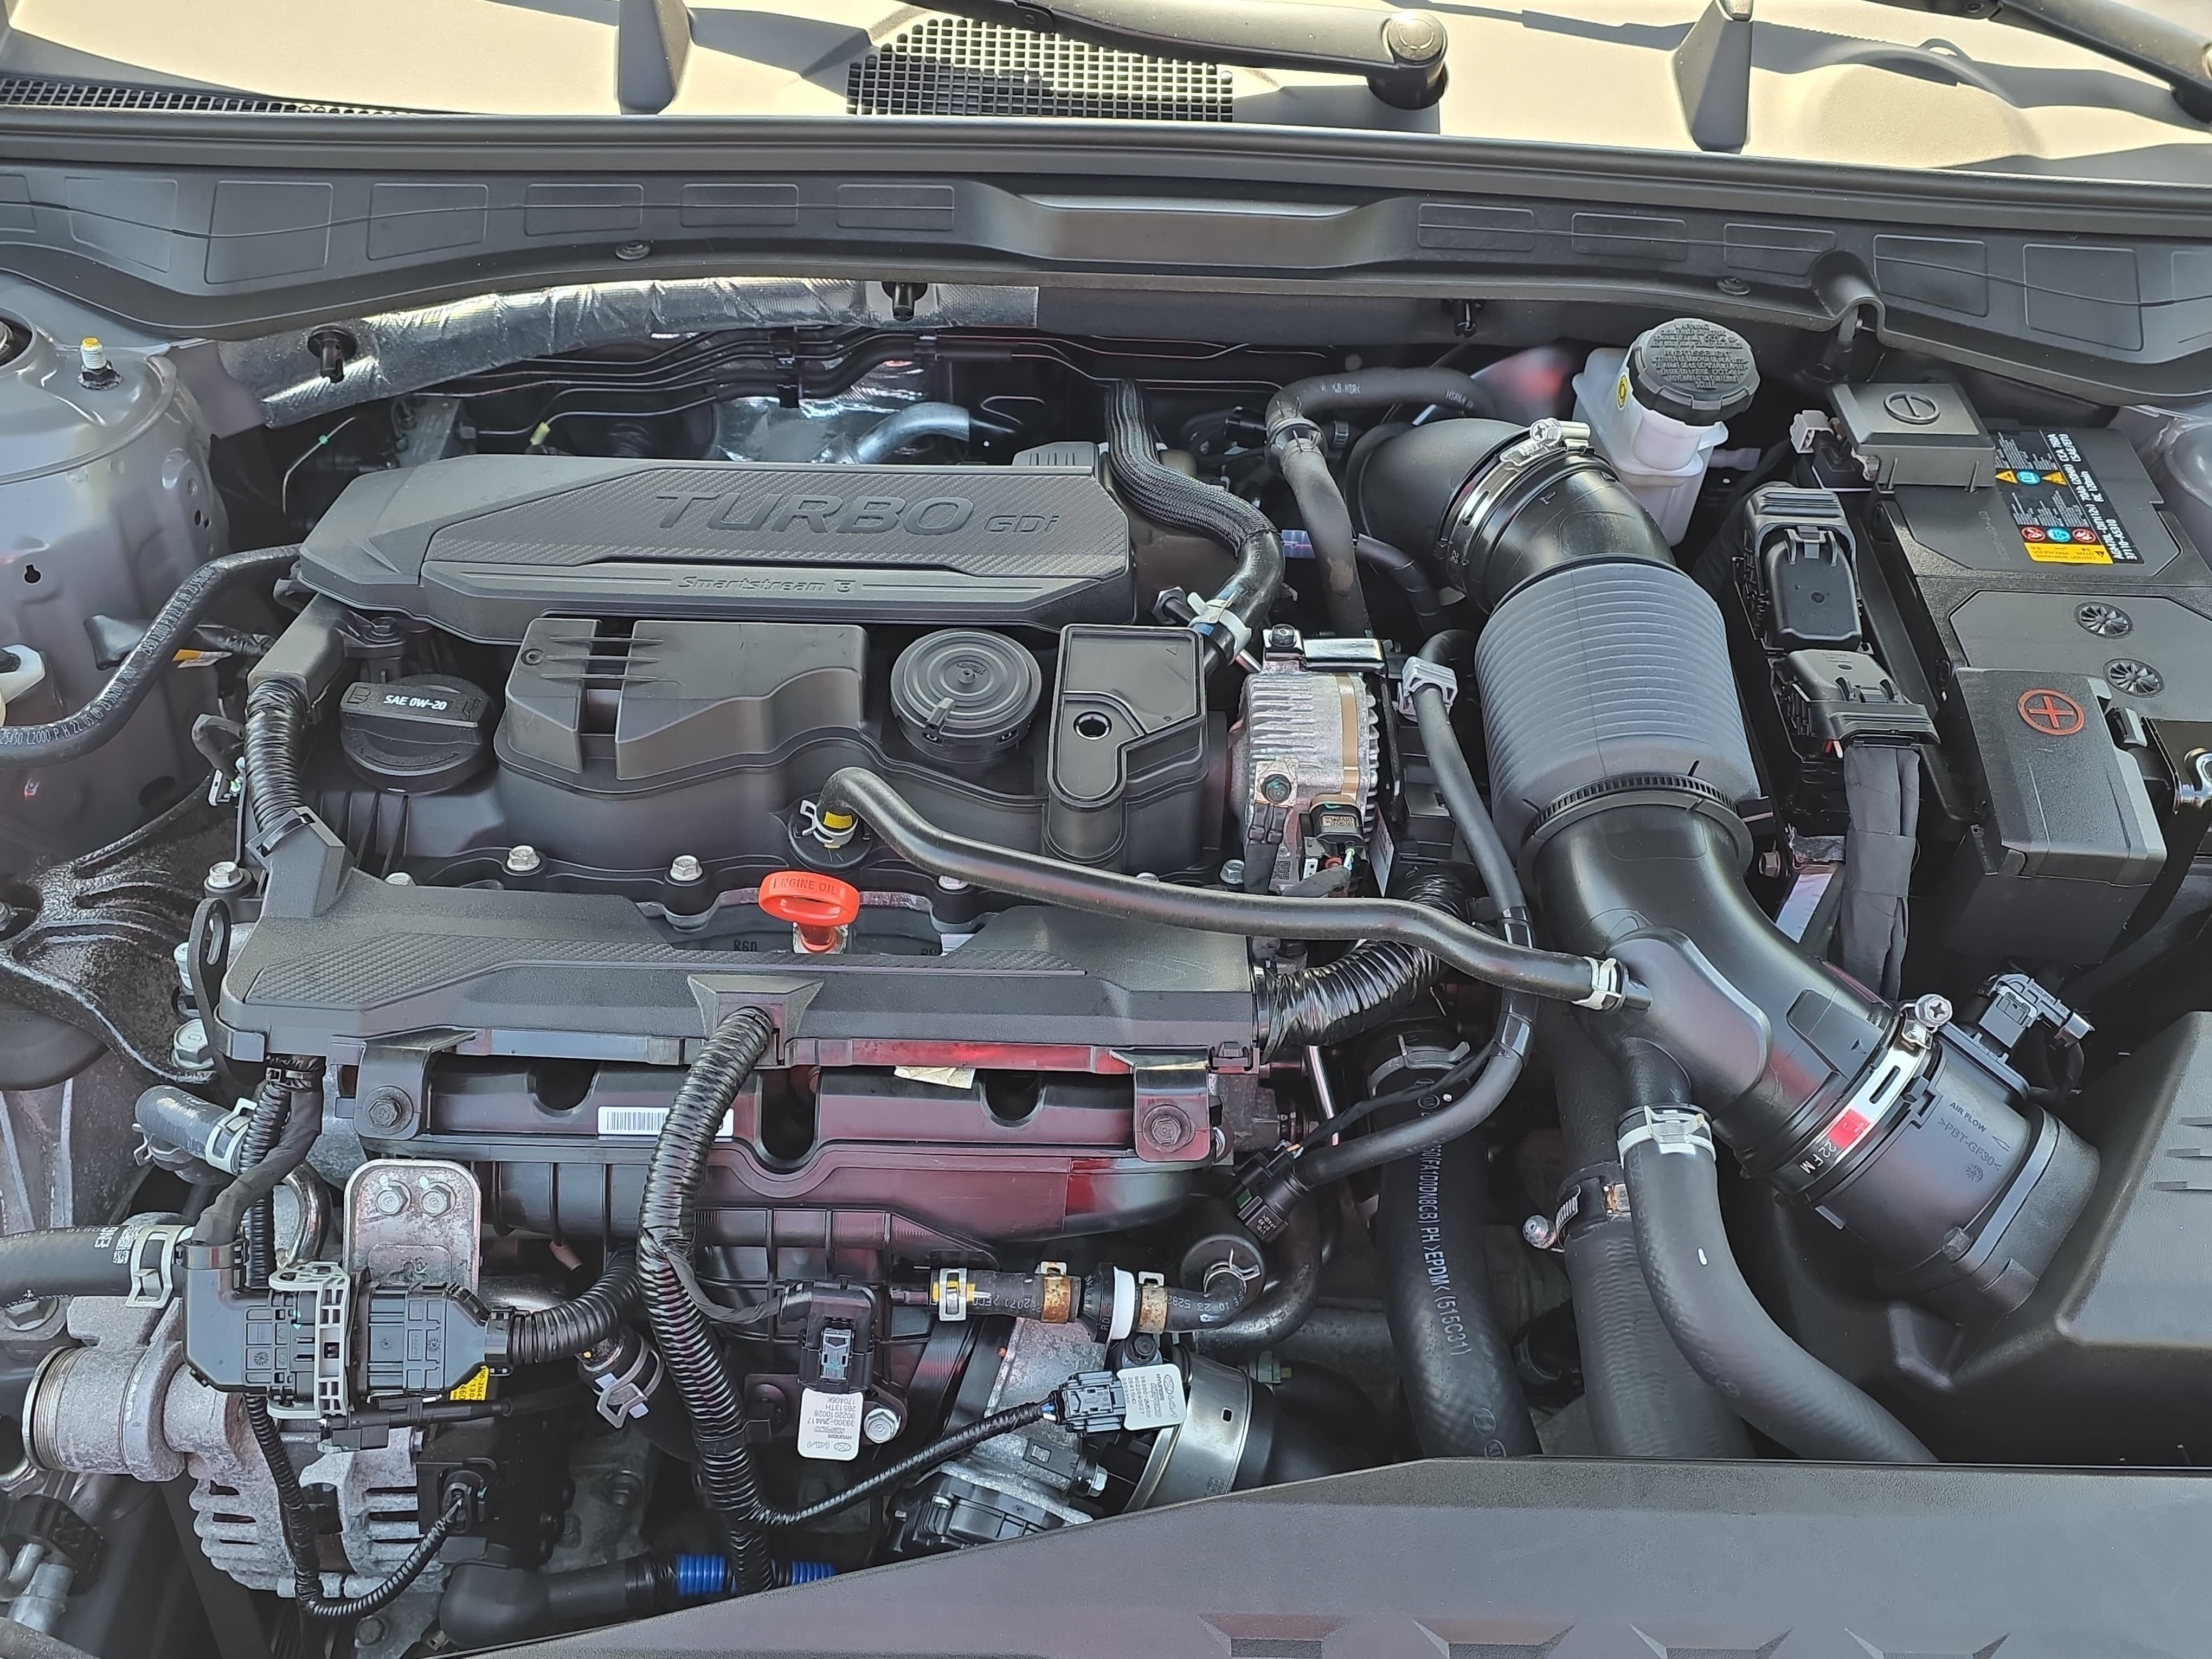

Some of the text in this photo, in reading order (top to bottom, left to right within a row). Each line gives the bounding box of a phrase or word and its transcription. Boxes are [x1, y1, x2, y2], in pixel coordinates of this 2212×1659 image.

[2057, 449, 2070, 461] CCA
[656, 491, 1060, 536] TURBO GDi
[677, 576, 826, 593] Smartstream
[383, 695, 448, 711] SAE 0W-20
[819, 883, 838, 895] OIL
[1949, 1102, 1987, 1132] AIR FLOW
[1420, 1226, 1441, 1242] PH
[1423, 1245, 1451, 1293] >EPDM<
[1433, 1296, 1472, 1356] (515C31)
